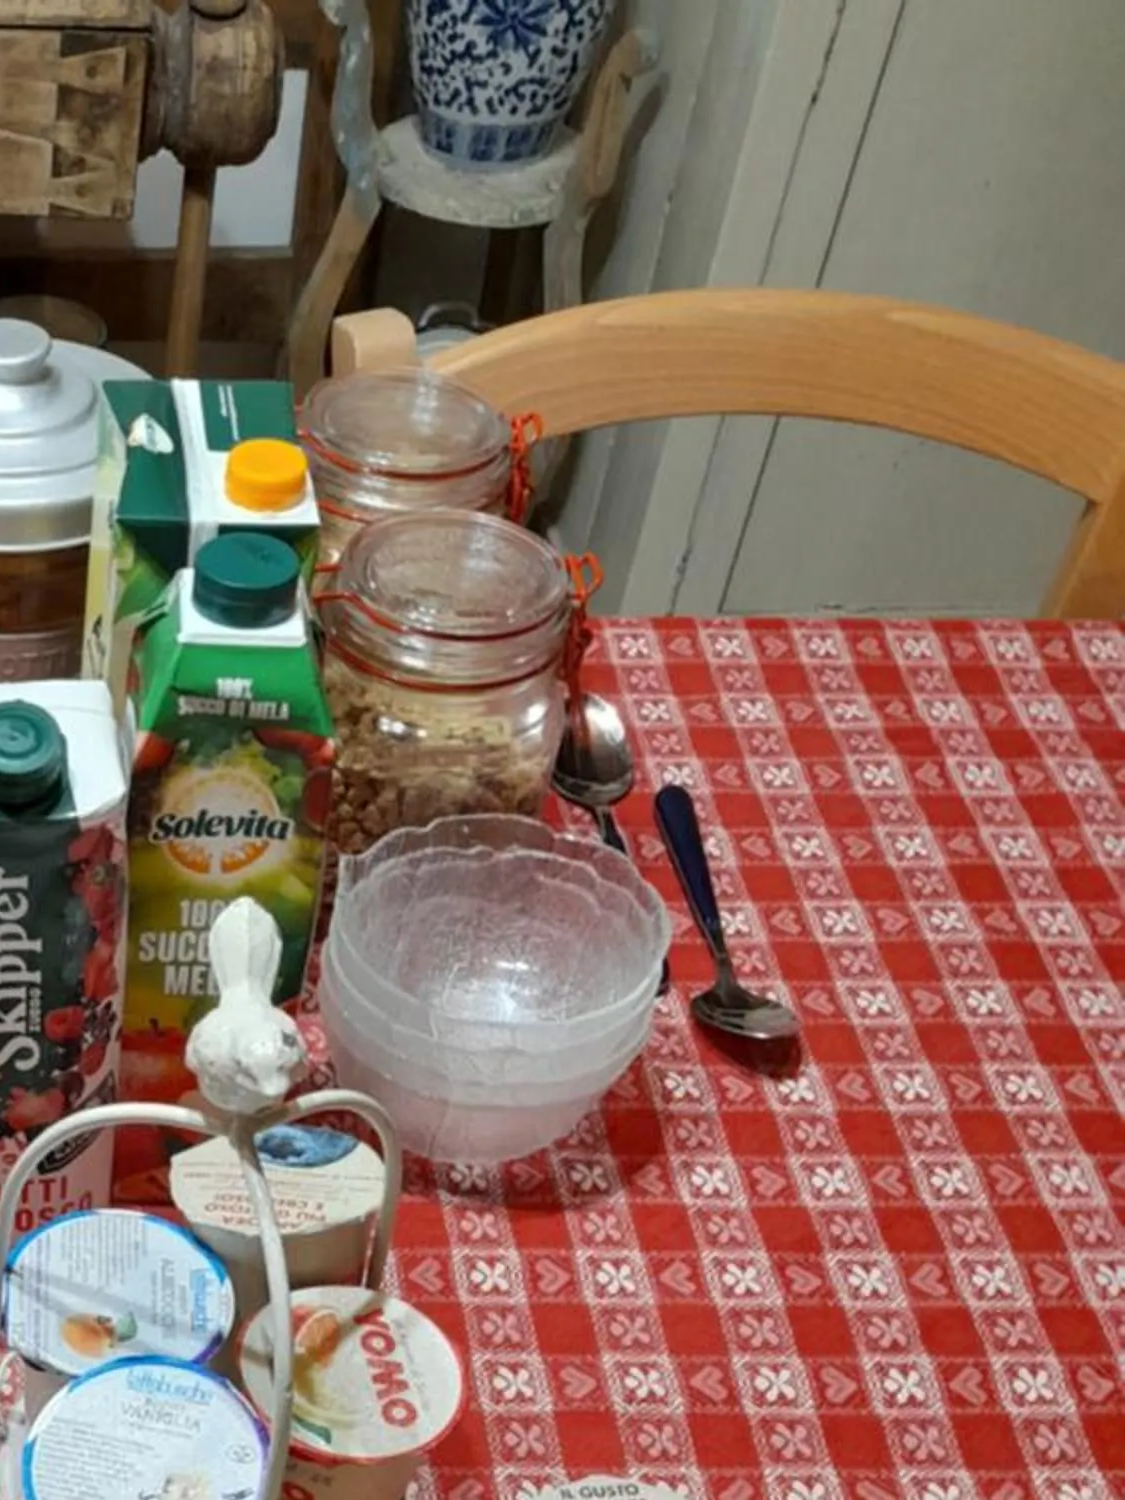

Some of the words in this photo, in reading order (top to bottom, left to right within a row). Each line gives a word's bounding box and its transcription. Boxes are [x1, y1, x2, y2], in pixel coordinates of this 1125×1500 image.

[151, 808, 291, 842] Solevita
[138, 931, 211, 963] SUCC
[560, 1487, 574, 1499] IL
[578, 1483, 640, 1499] GUSTO
